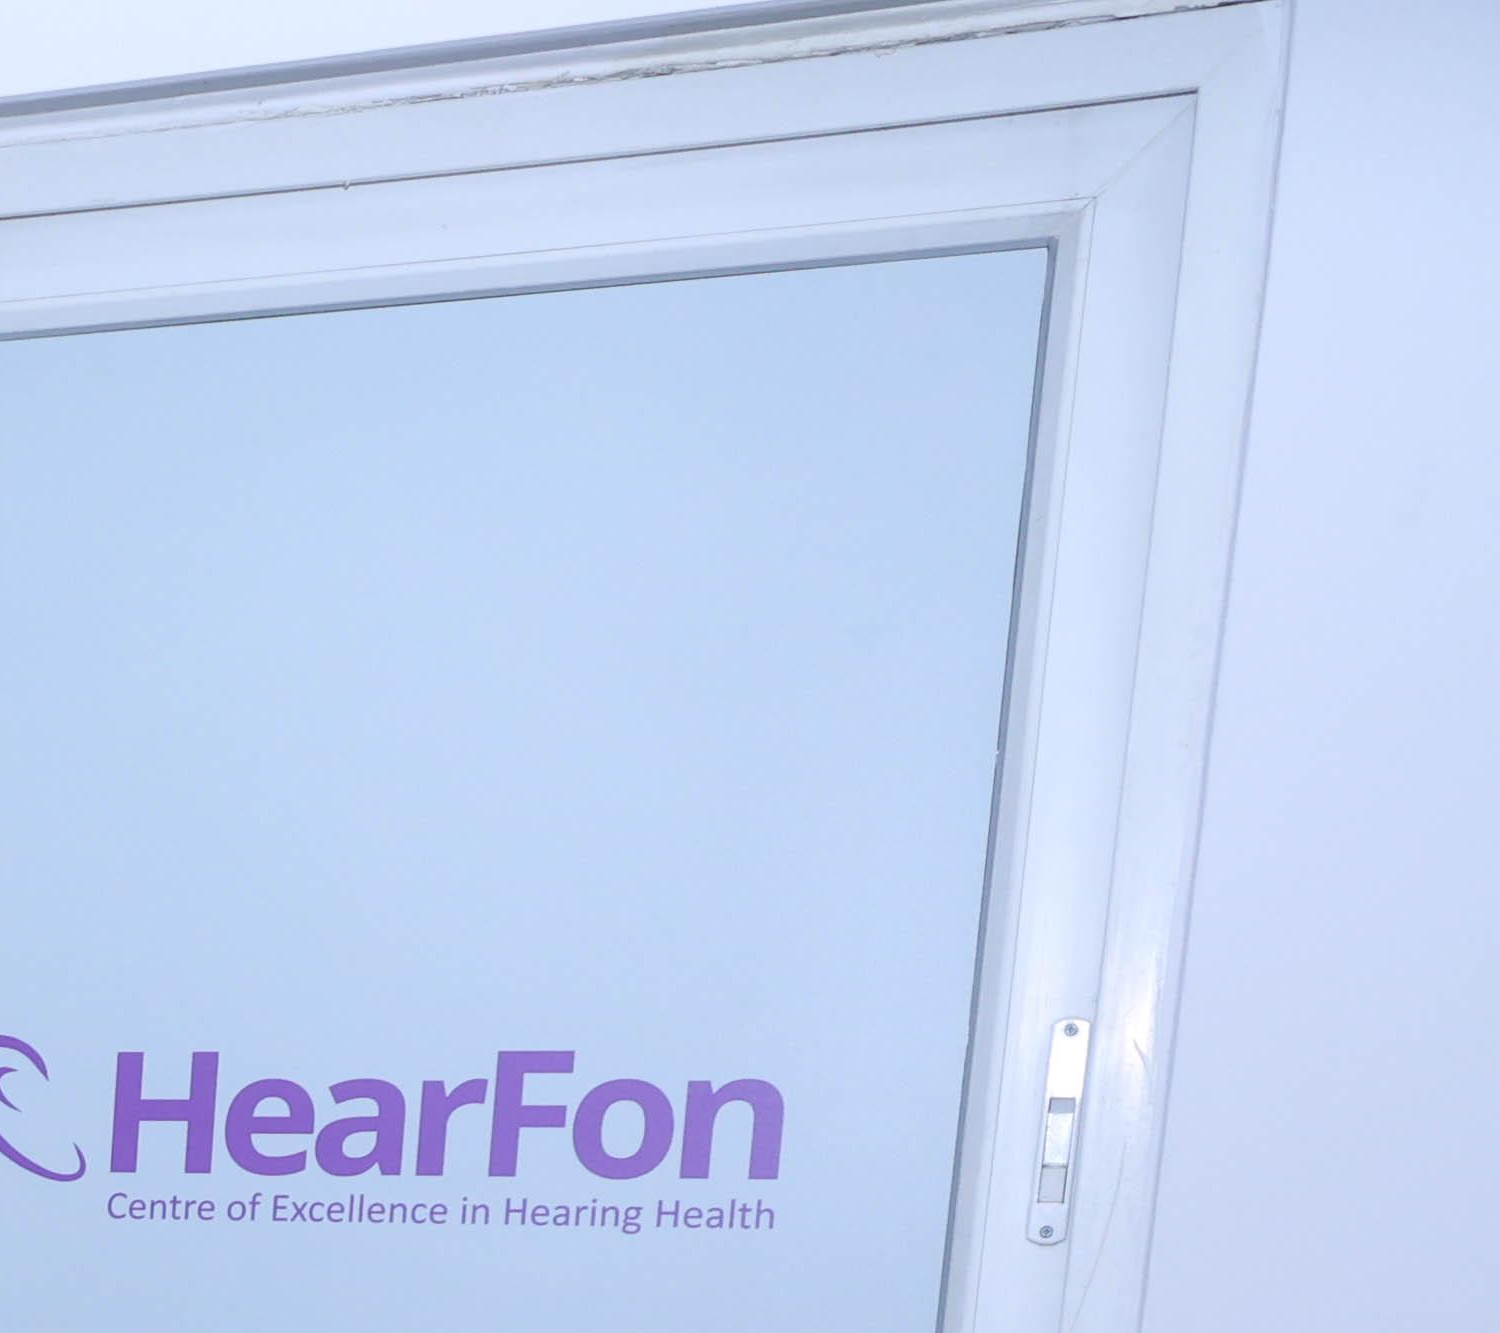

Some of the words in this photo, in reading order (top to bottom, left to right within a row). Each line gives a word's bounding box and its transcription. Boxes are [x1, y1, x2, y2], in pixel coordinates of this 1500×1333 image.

[109, 1050, 784, 1180] HearFon
[106, 1191, 216, 1222] Centre
[226, 1191, 264, 1222] of
[271, 1193, 449, 1225] Excellence
[460, 1195, 490, 1226] in
[503, 1197, 645, 1235] Hearing
[655, 1198, 775, 1230] Health
